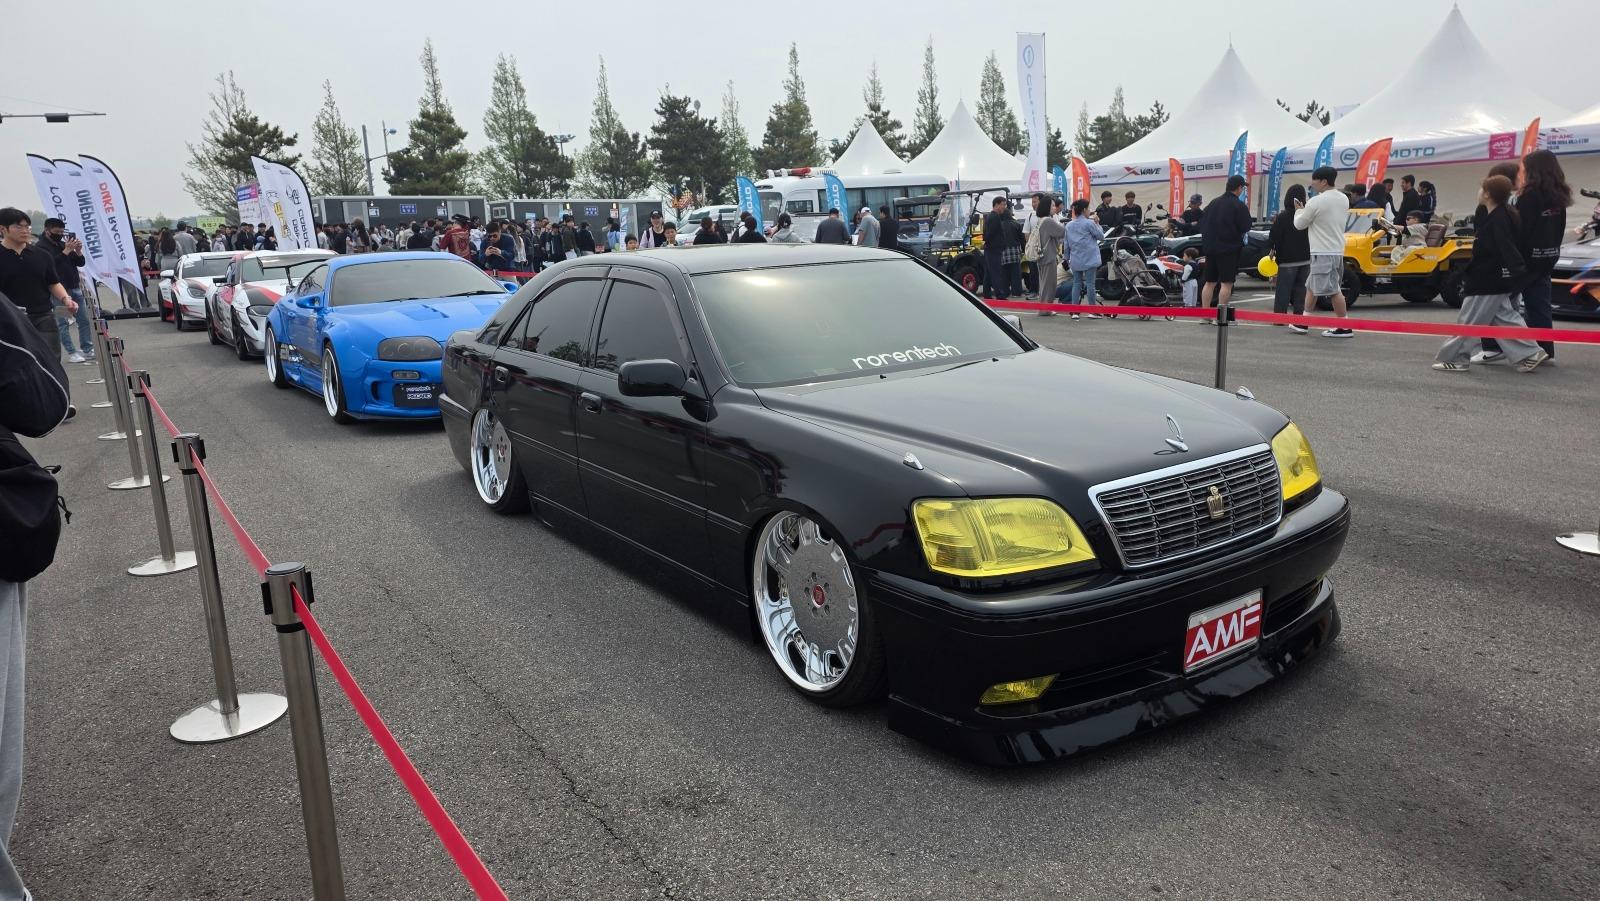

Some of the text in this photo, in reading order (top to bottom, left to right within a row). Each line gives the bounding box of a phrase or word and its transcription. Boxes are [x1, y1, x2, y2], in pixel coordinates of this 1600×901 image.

[1389, 146, 1436, 158] MOTO
[1187, 163, 1224, 172] GOES
[852, 342, 962, 370] rorentech
[1186, 603, 1261, 664] AMF
